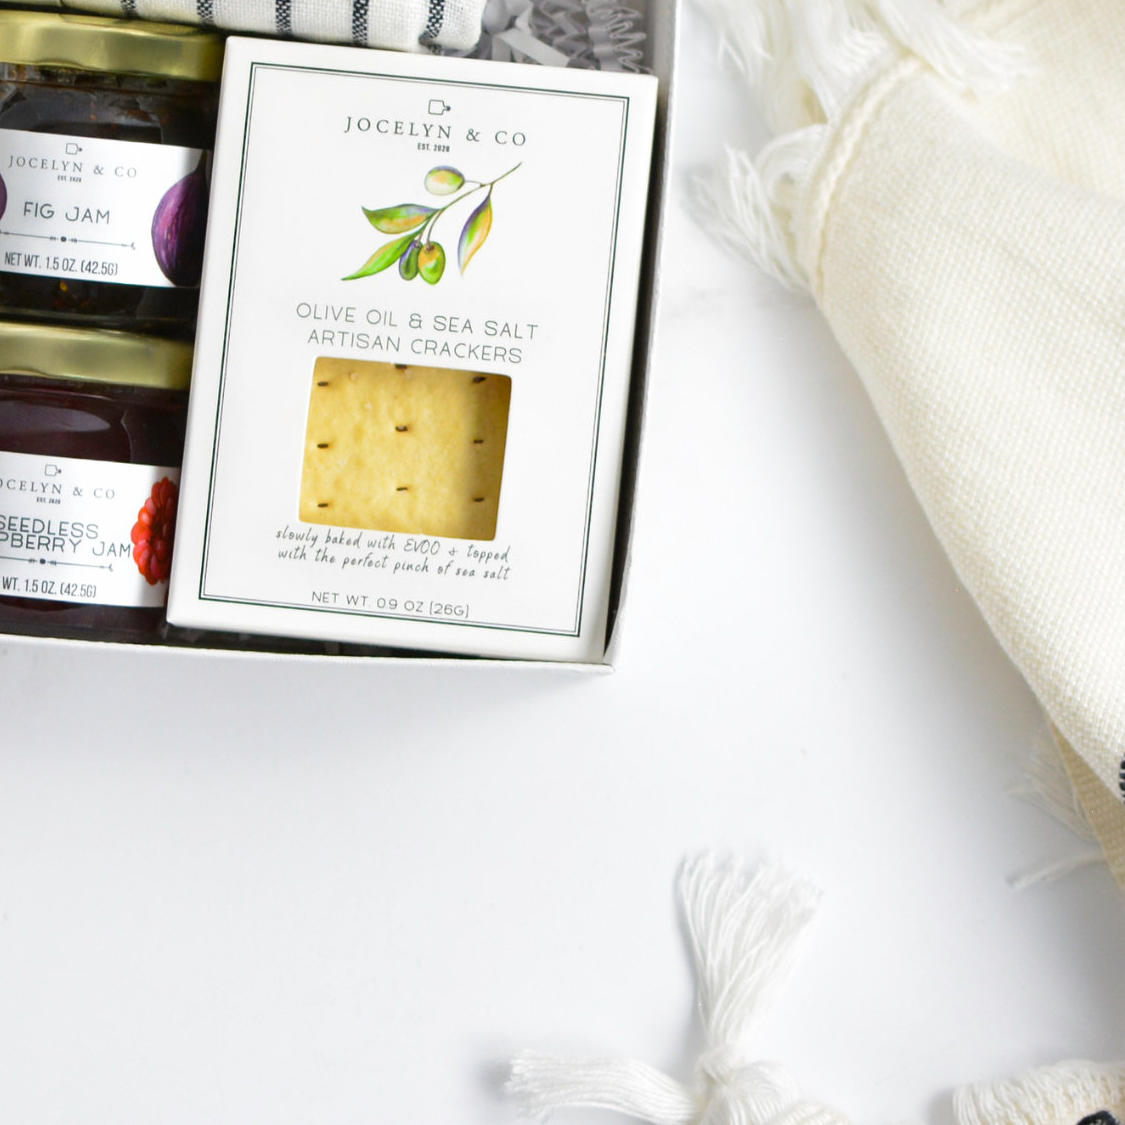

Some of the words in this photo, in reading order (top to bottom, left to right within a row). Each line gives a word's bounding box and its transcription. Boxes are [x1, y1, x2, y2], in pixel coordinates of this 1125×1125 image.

[343, 116, 452, 139] JOCELYN
[466, 128, 481, 142] &
[494, 130, 526, 146] CO
[417, 142, 431, 151] EST.
[433, 144, 450, 153] 2020
[8, 155, 83, 172] JOCELYN
[93, 165, 104, 175] &
[114, 166, 137, 178] CO
[23, 202, 55, 219] FIG
[65, 206, 110, 225] JAM
[5, 252, 22, 266] NET
[24, 254, 42, 269] WT.
[46, 257, 59, 270] 1.5
[62, 258, 78, 272] OZ.
[80, 260, 118, 276] (42.5G)
[296, 302, 356, 323] OLIVE
[366, 309, 398, 327] OIL
[409, 312, 423, 329] &
[433, 315, 473, 334] SEA
[484, 320, 539, 340] SALT
[307, 328, 401, 352] ARTISAN
[410, 337, 522, 364] CRACKERS
[73, 486, 84, 497] &
[93, 488, 115, 500] CO
[92, 541, 131, 559] JAM
[275, 525, 318, 547] slowly
[325, 529, 360, 549] baked
[367, 534, 395, 551] with
[403, 539, 441, 556] EVOO
[467, 544, 511, 562] topped
[278, 544, 307, 561] with
[315, 547, 336, 565] the
[342, 553, 389, 569] perfect
[393, 557, 429, 574] pinch
[437, 561, 453, 575] of
[455, 567, 476, 578] sea
[483, 564, 511, 581] salt
[2, 576, 20, 592] WT.
[24, 579, 39, 592] 1.5
[41, 580, 57, 595] OZ.
[59, 582, 96, 598] (42.5G)
[311, 591, 340, 604] NET
[346, 594, 371, 608] WT.
[376, 597, 398, 610] 0.9
[404, 599, 424, 613] OZ
